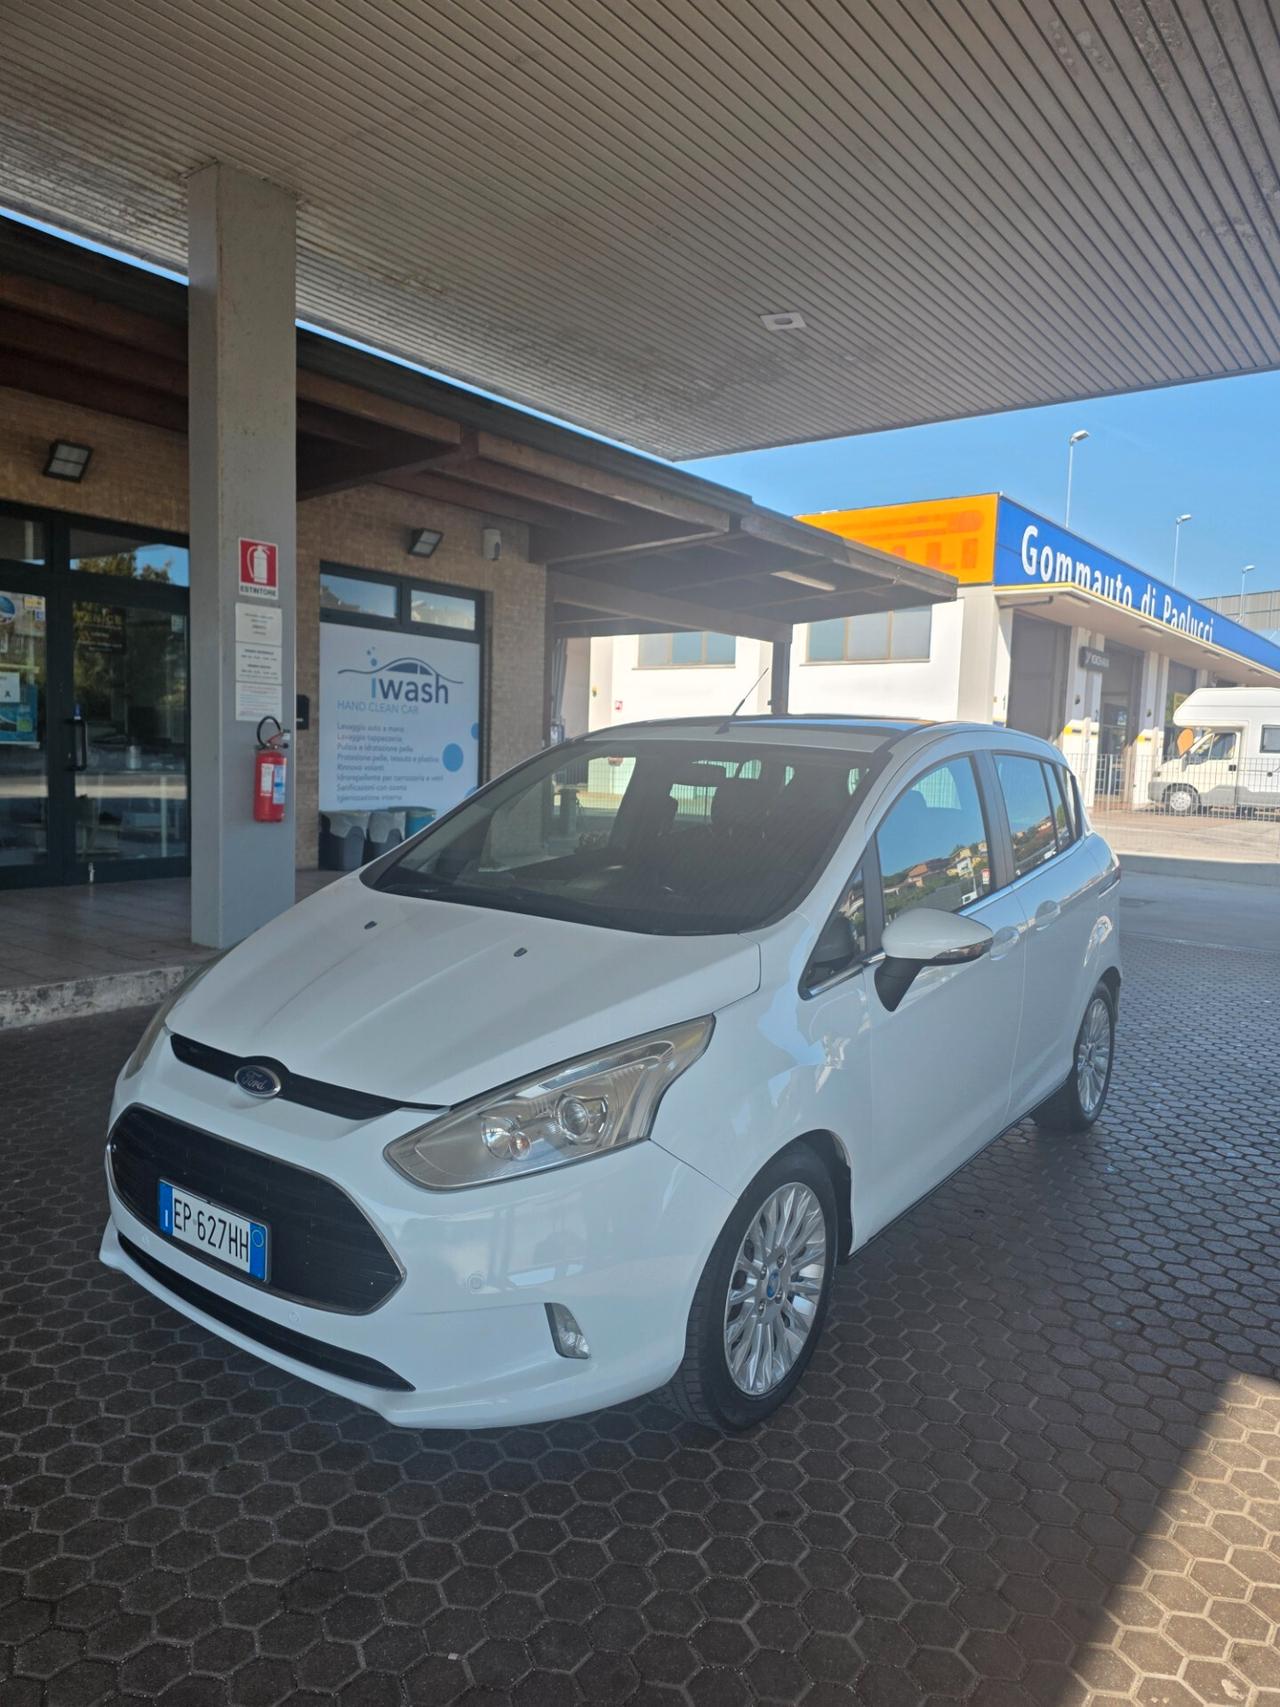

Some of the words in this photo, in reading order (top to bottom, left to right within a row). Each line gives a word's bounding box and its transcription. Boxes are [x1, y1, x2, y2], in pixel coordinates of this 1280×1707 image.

[240, 585, 277, 597] ESTINTORE
[1021, 525, 1133, 609] Gommauto
[1140, 583, 1156, 619] di
[1162, 594, 1214, 644] Paolucci
[337, 701, 366, 712] HAND
[368, 702, 399, 713] CLEAN
[401, 704, 419, 715] CAR
[337, 722, 366, 732] Lavaggio
[337, 733, 366, 743] Lavaggio
[174, 1197, 192, 1232] EP
[197, 1211, 249, 1263] 627HH
